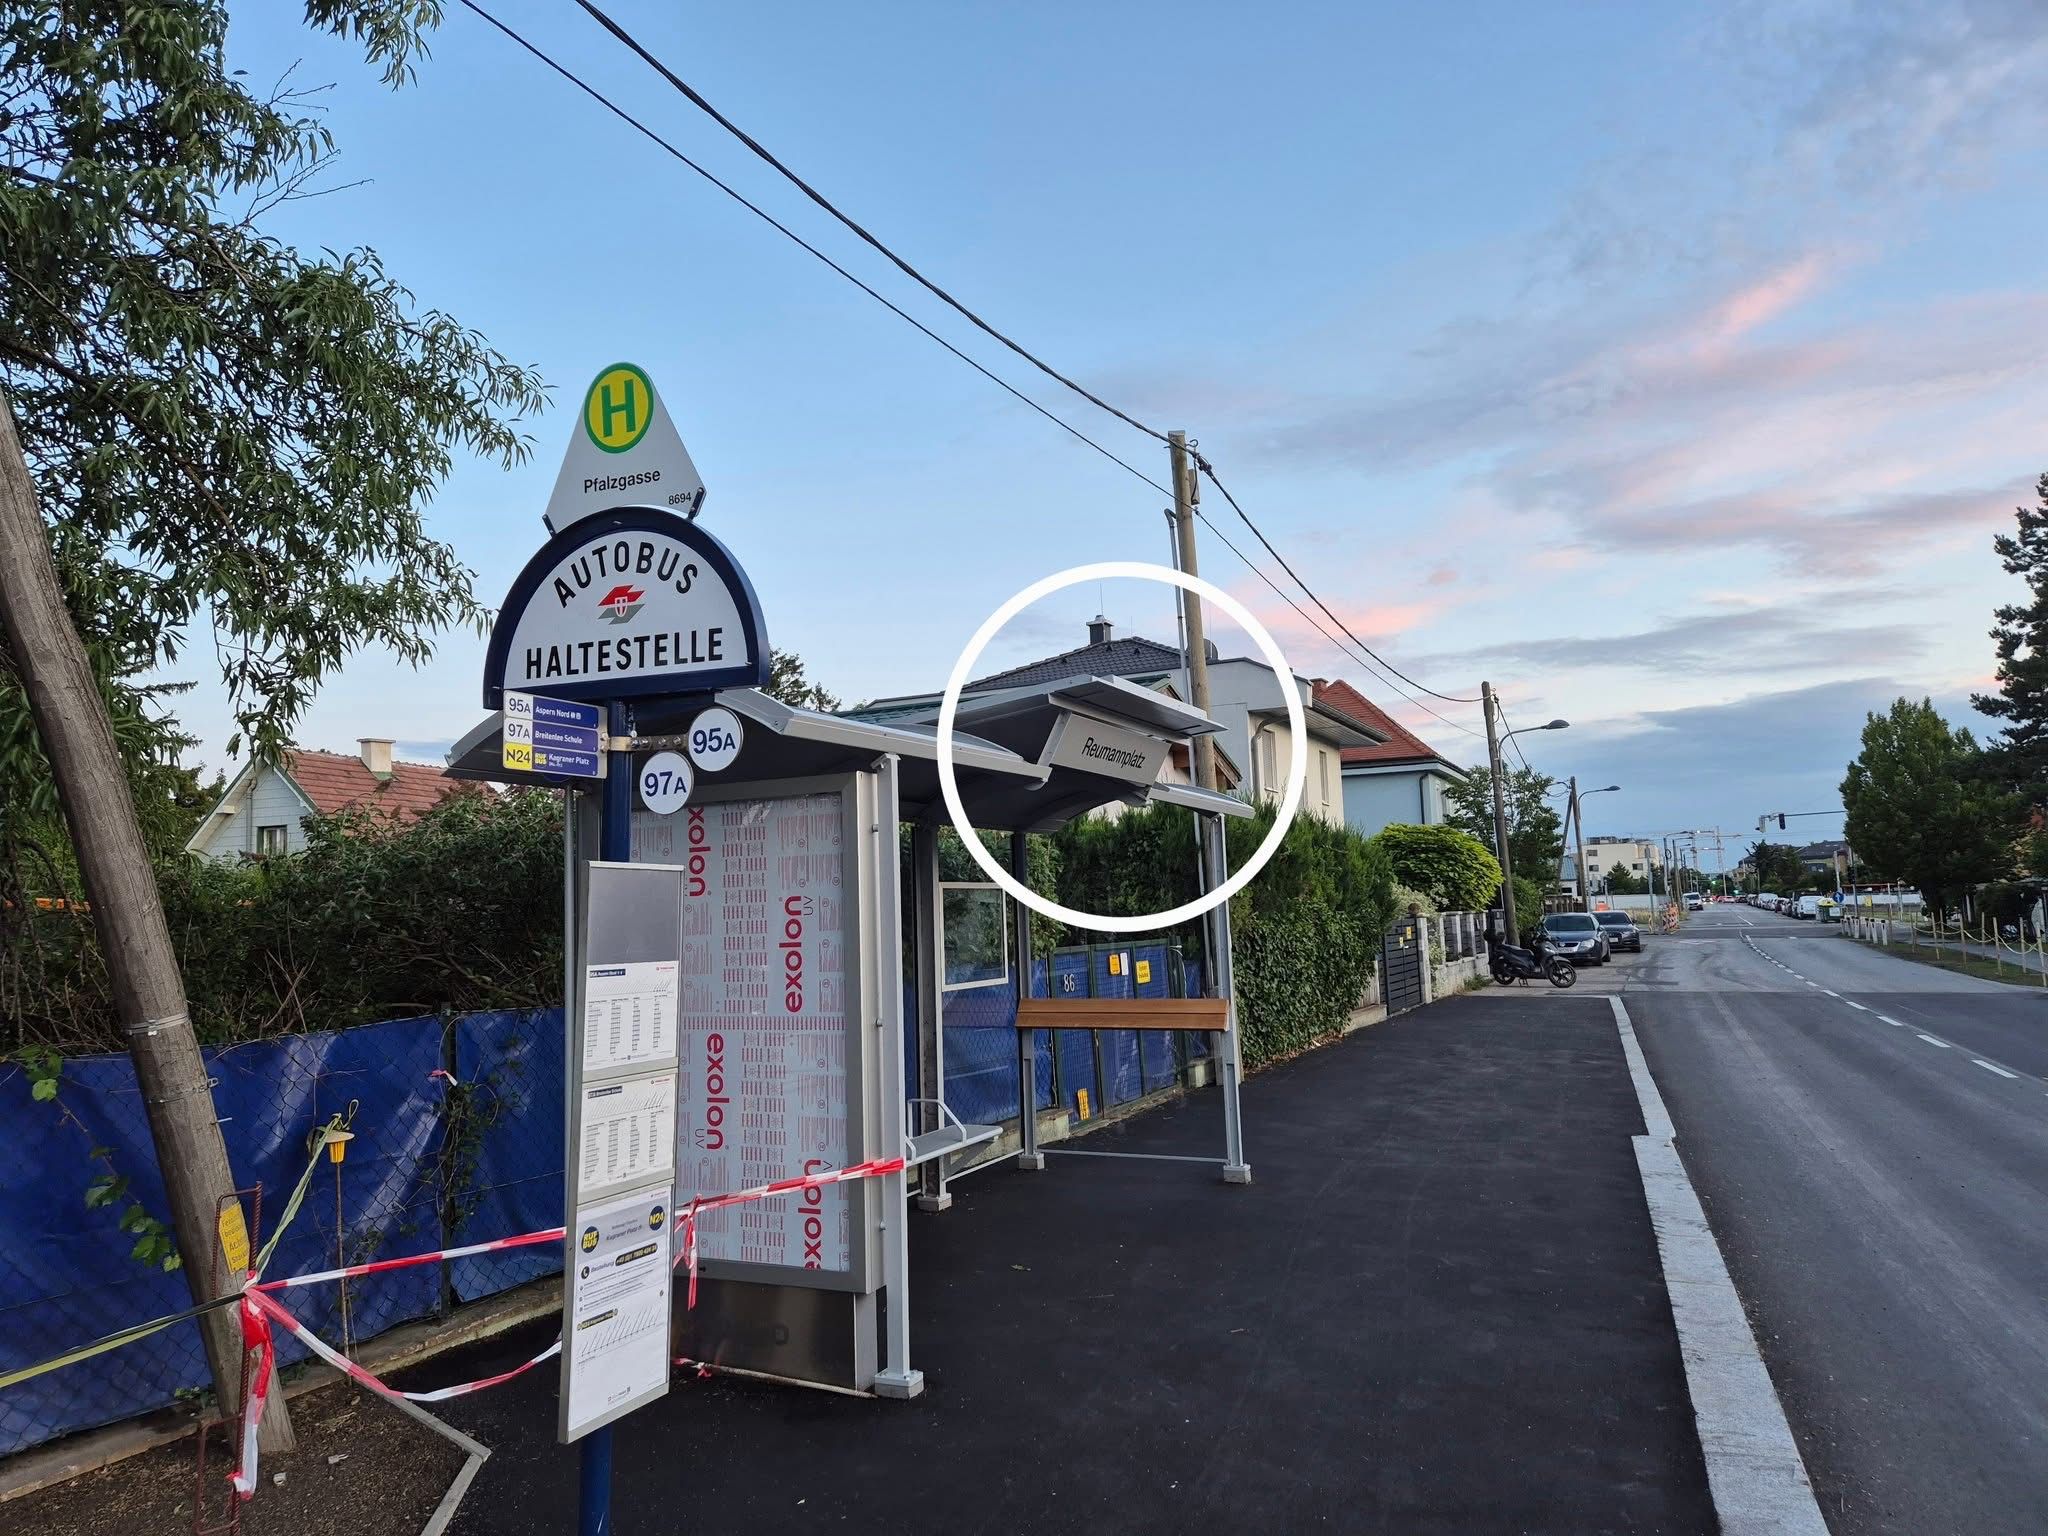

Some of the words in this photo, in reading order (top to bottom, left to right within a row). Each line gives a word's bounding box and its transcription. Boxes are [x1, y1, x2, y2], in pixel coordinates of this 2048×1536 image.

[601, 379, 636, 437] H
[584, 470, 660, 493] Pfalzgasse
[668, 492, 691, 505] 8694
[553, 541, 698, 608] AUTOBUS
[526, 627, 723, 679] HALTESTELLE
[509, 698, 531, 713] 95A
[535, 706, 555, 717] Aspern
[556, 709, 571, 718] Nord
[508, 723, 530, 739] 97A
[535, 730, 564, 742] Breitenlee
[564, 734, 583, 744] Schule
[692, 727, 736, 754] 95A
[506, 749, 531, 763] N24
[575, 756, 589, 765] Platz
[1081, 737, 1146, 768] Reumannplatz
[644, 771, 687, 797] 97A
[688, 807, 711, 896] xolon
[803, 896, 814, 916] UV
[779, 895, 802, 1013] exolon
[1064, 974, 1075, 992] 86
[707, 1033, 730, 1150] exolon
[695, 1128, 704, 1149] UV
[648, 1210, 666, 1225] N24
[582, 1238, 597, 1249] BUS
[584, 1231, 598, 1241] RUF
